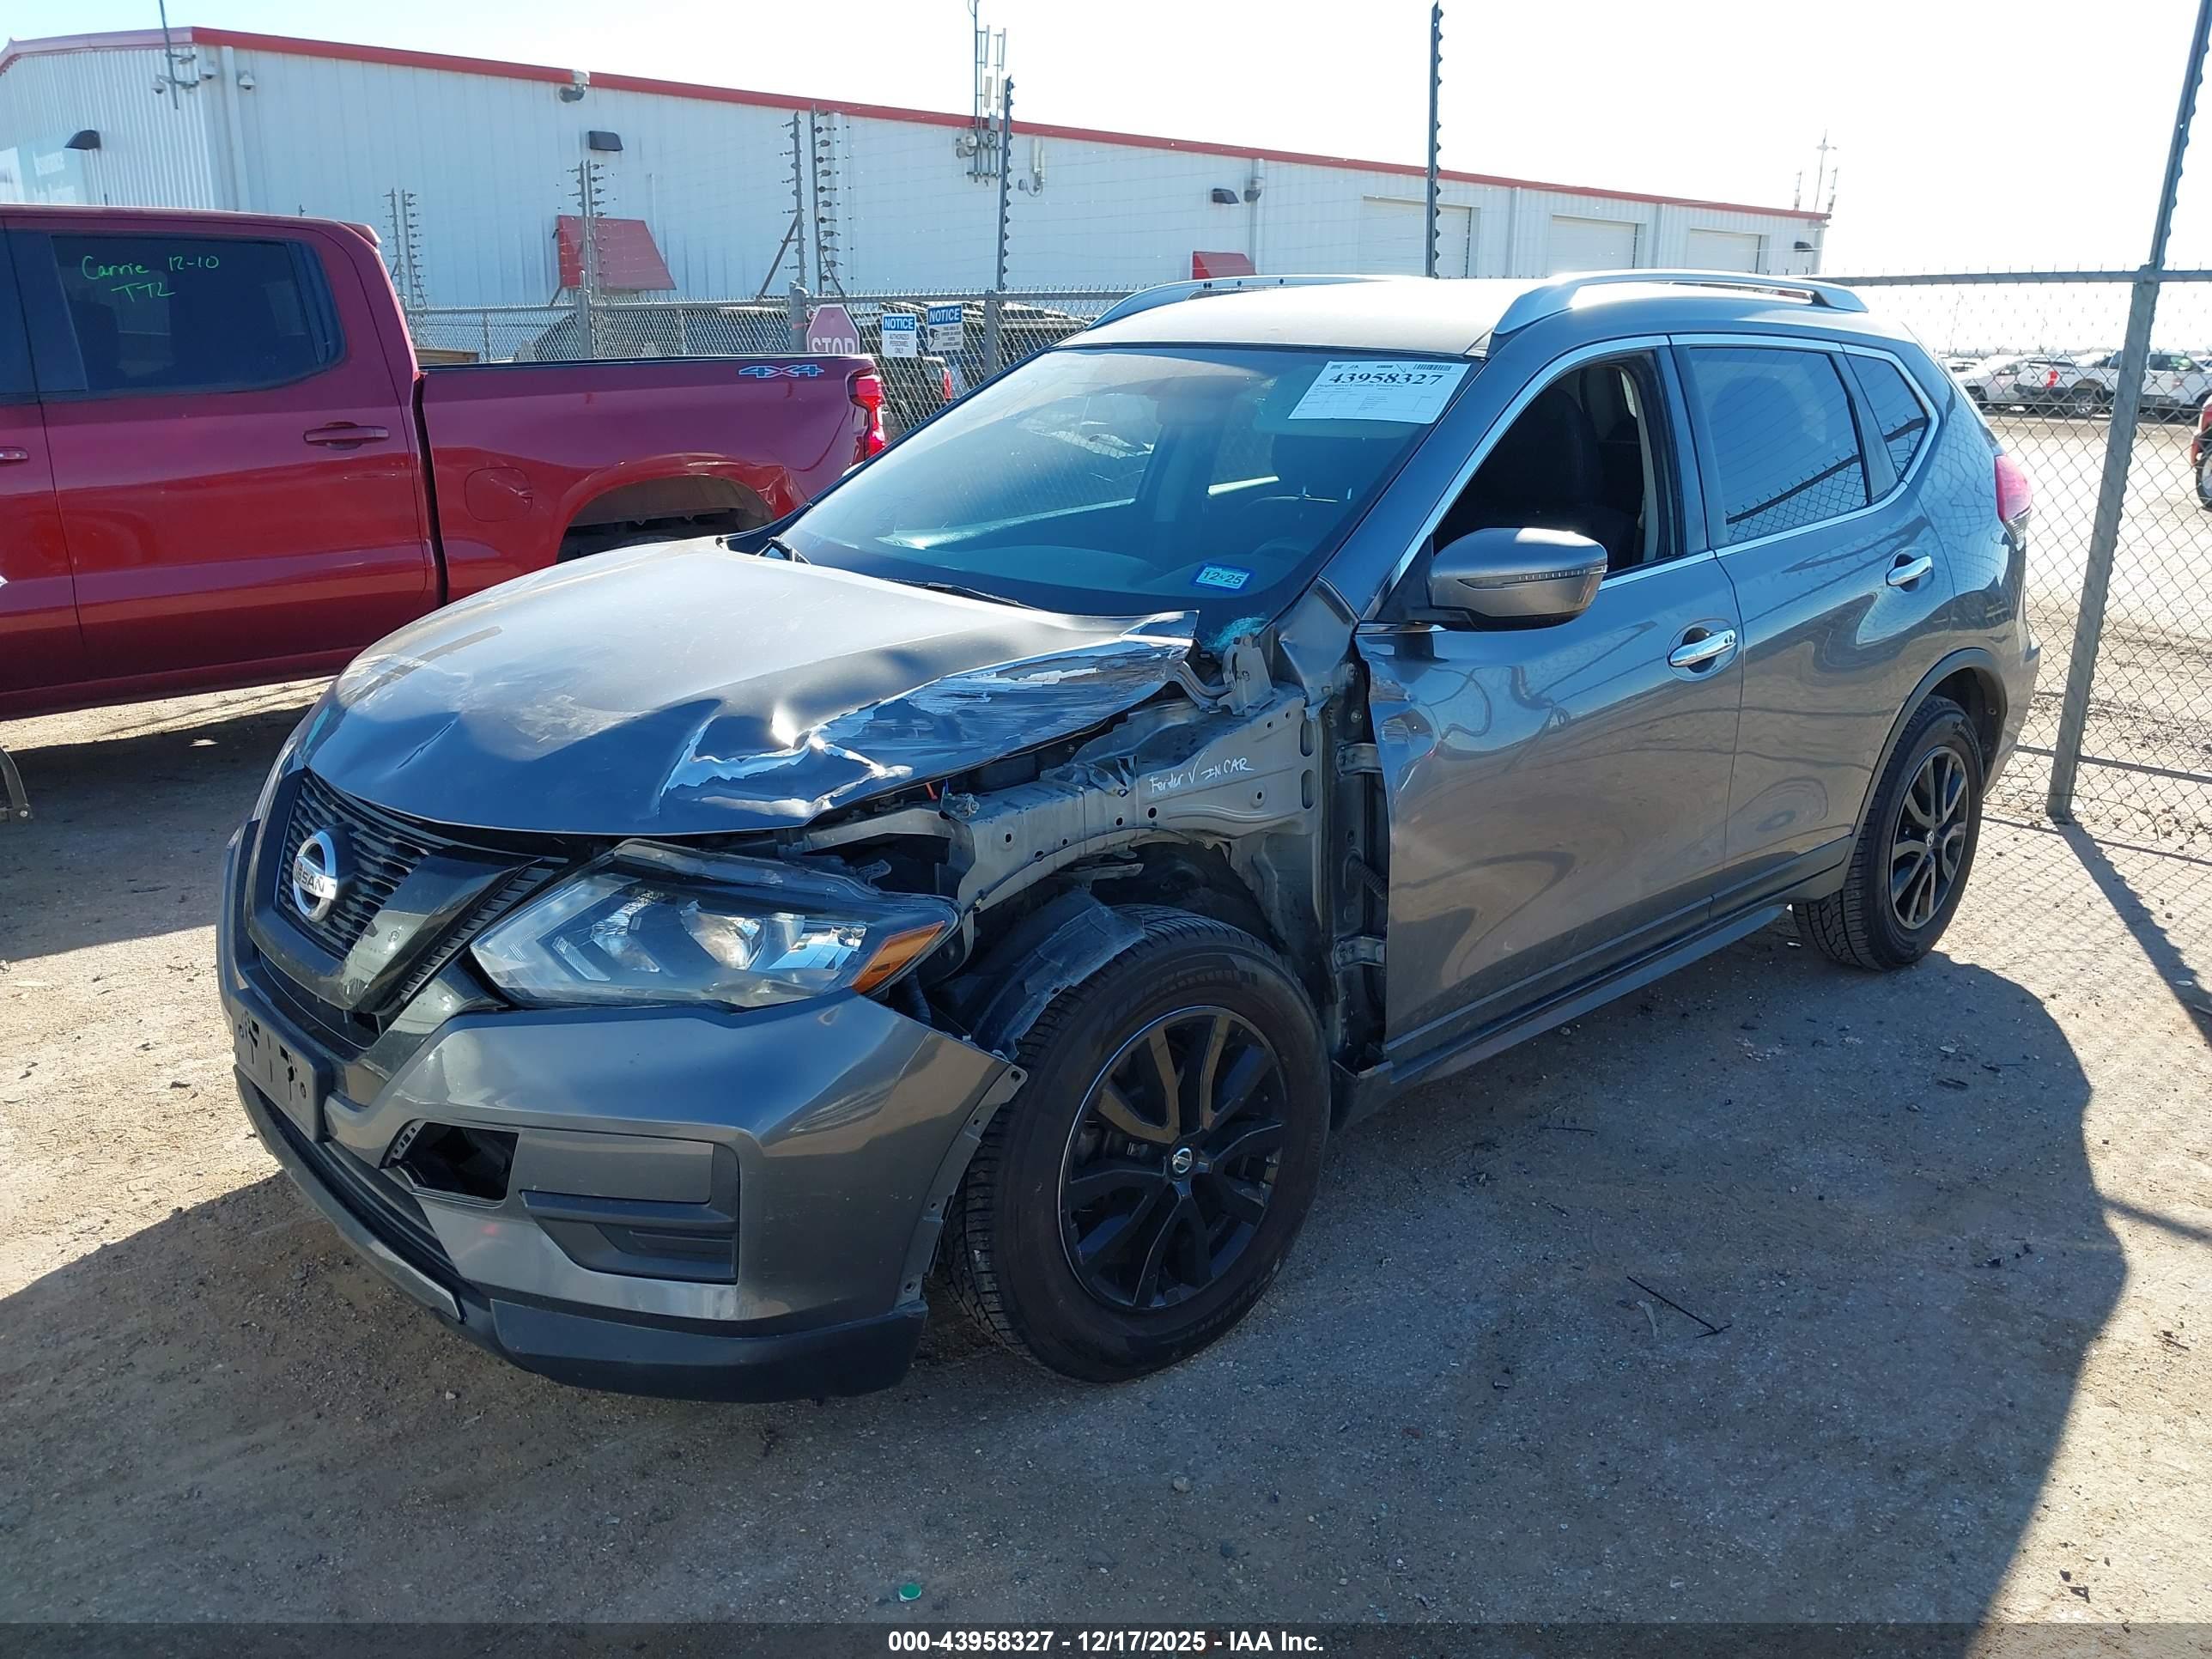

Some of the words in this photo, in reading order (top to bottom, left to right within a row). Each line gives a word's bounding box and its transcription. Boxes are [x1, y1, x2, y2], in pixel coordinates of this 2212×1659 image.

[929, 307, 961, 323] NOTICE
[884, 318, 915, 330] NOTICE
[1328, 373, 1444, 386] 43958327
